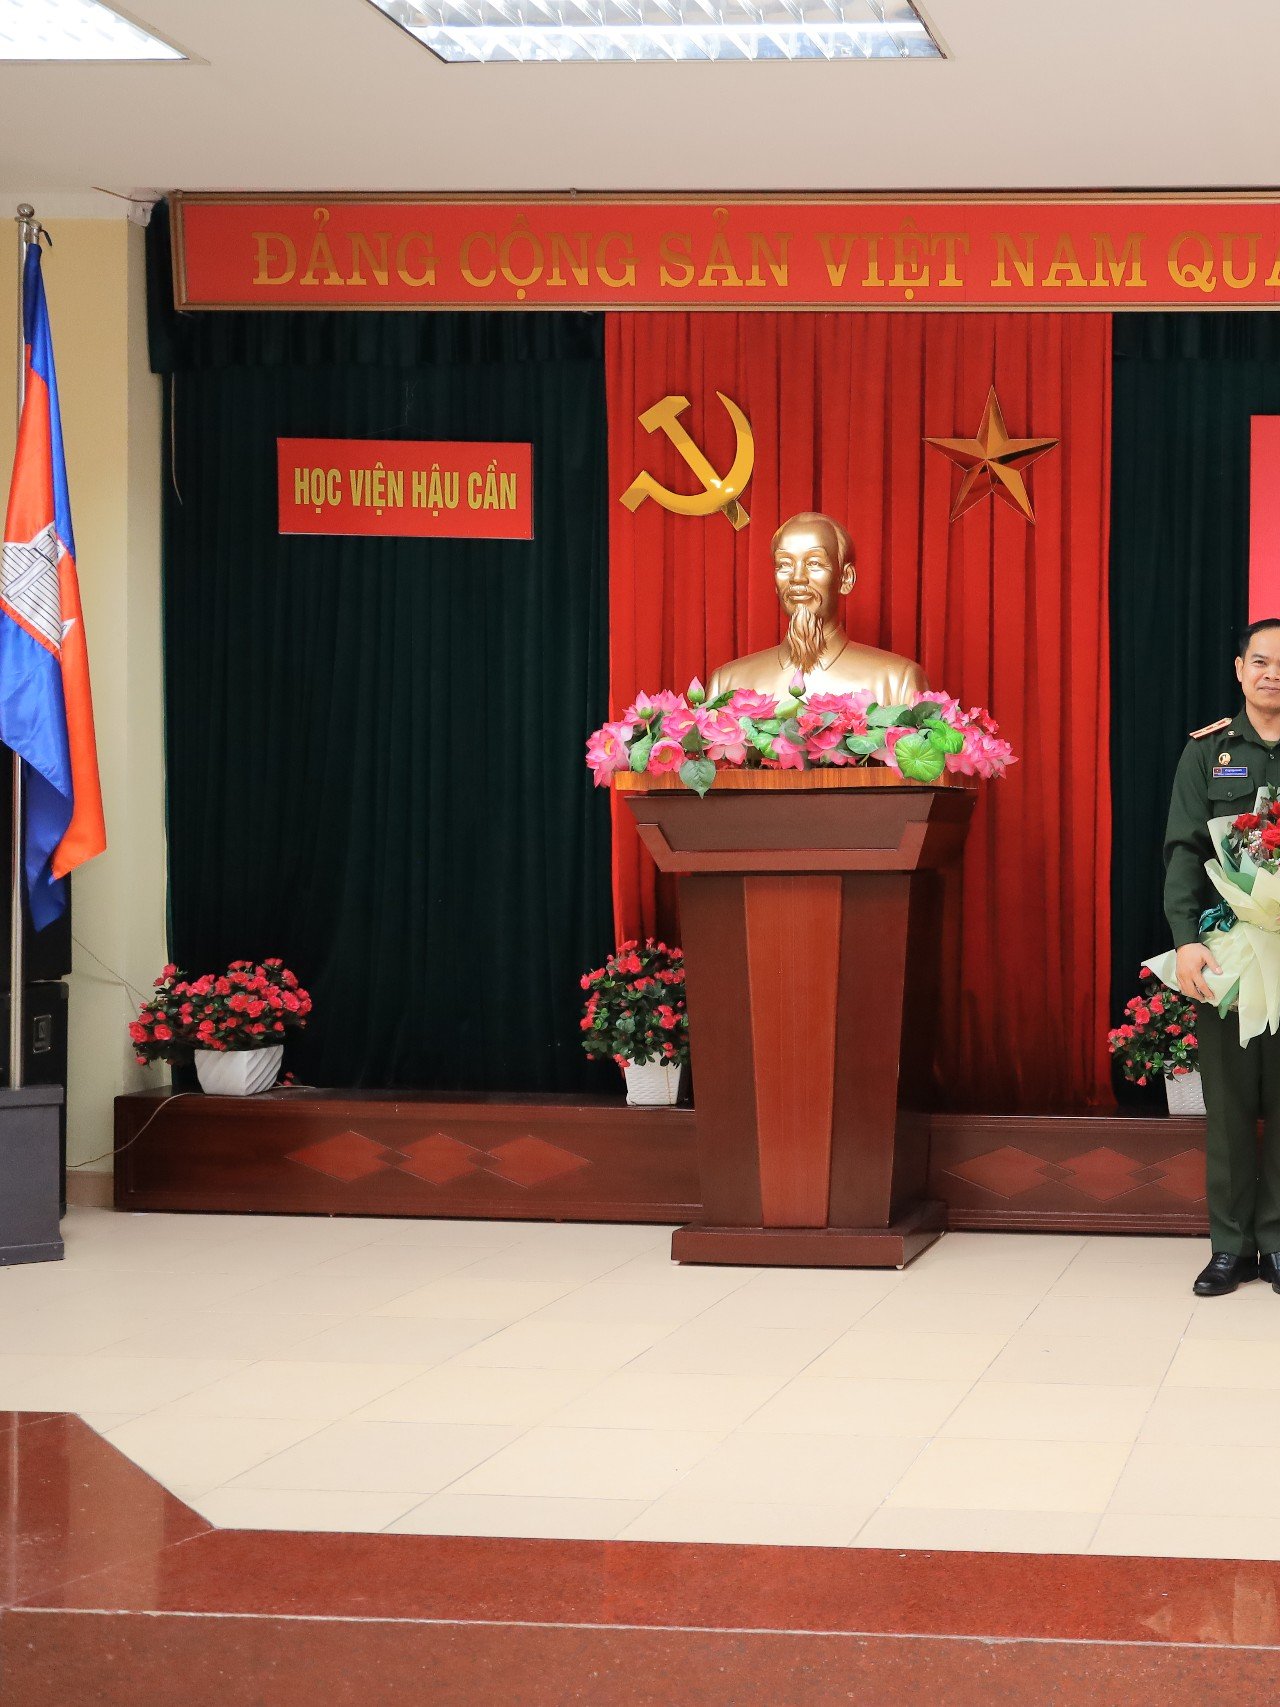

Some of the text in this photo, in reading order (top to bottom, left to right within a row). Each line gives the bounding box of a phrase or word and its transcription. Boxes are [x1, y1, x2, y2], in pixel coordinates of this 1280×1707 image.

[252, 208, 439, 288] ĐẢNG
[459, 214, 639, 301] CỘNG
[658, 207, 794, 289] SẢN
[817, 216, 970, 301] VIỆT
[989, 231, 1147, 288] NAM
[294, 459, 518, 517] HỌC VIỆN HẬU CẦN
